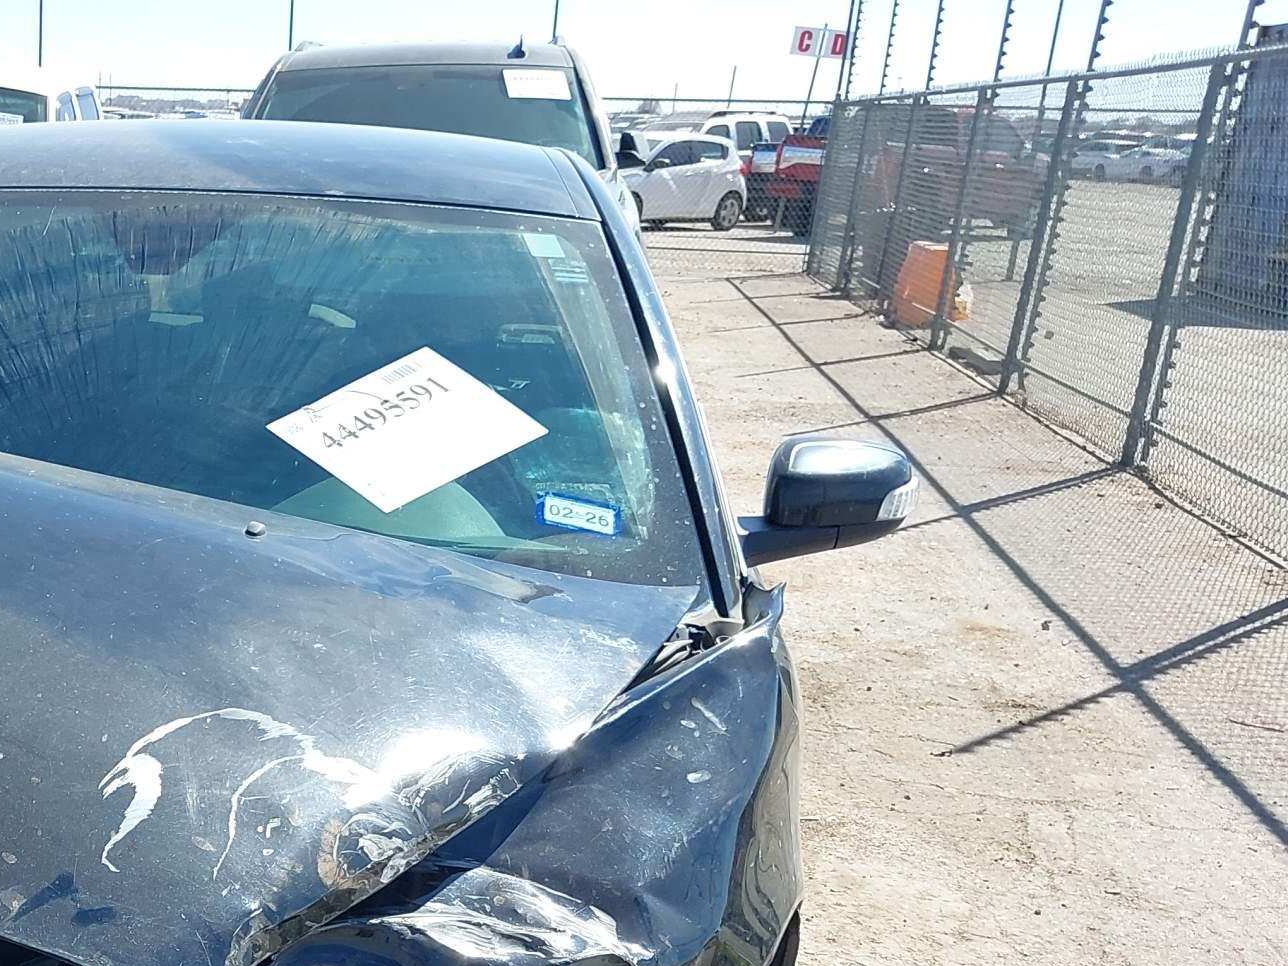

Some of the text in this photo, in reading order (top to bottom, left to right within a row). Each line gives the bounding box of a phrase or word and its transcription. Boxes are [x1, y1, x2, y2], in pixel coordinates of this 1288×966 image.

[798, 30, 847, 55] C D
[321, 376, 451, 449] 44495591
